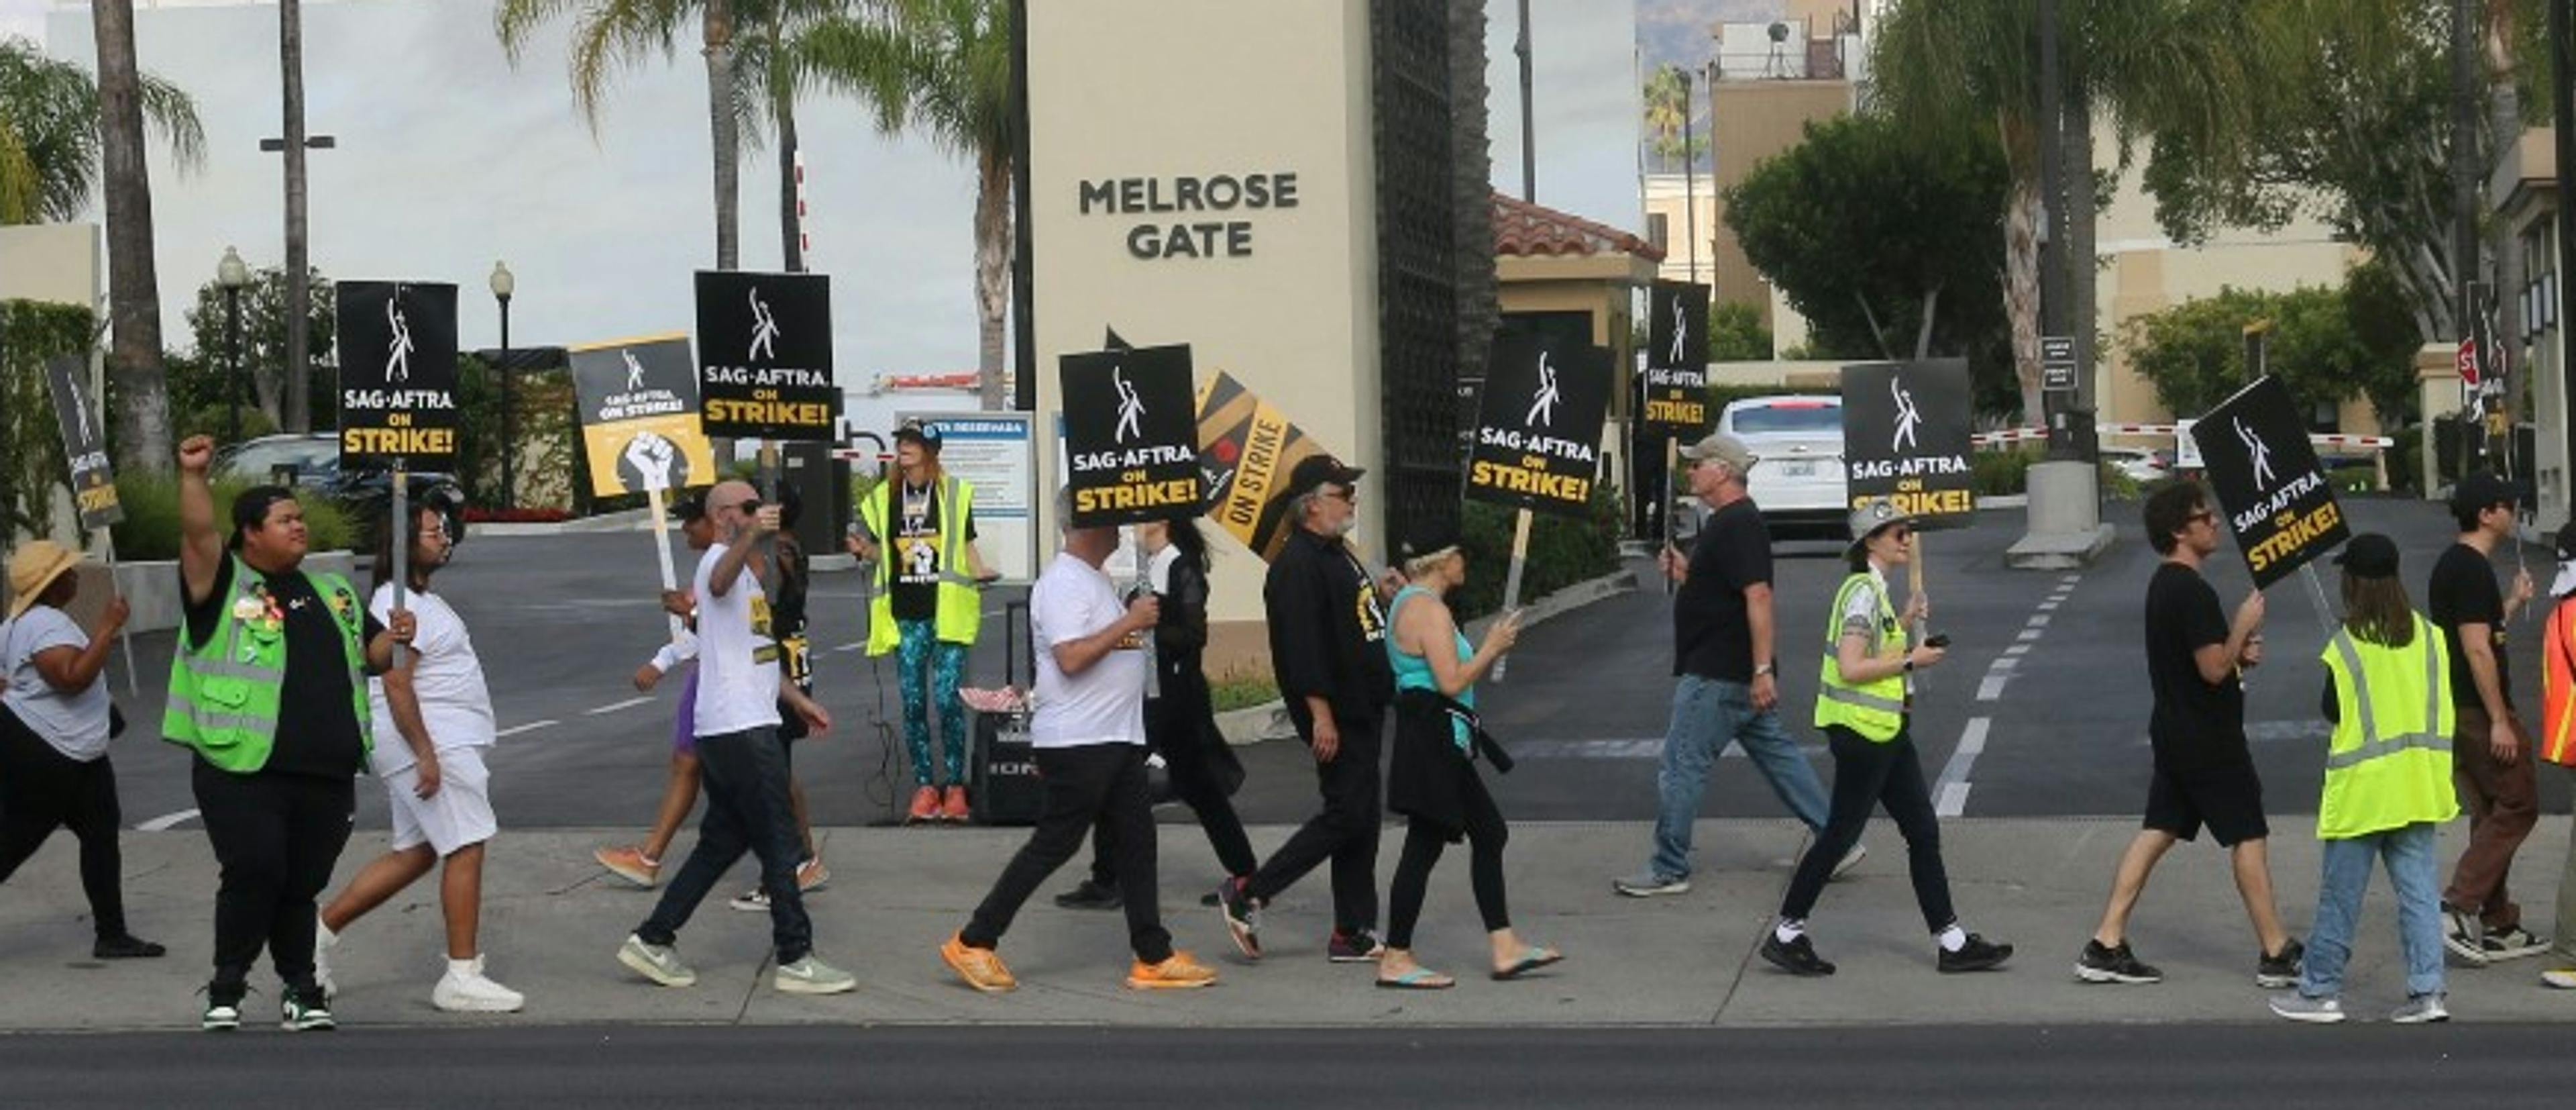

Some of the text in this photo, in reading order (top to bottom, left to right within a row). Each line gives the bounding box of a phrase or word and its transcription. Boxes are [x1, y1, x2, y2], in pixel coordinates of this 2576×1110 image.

[1079, 173, 1299, 214] MELROSE
[1127, 222, 1252, 260] GATE
[752, 389, 777, 400] ON
[388, 413, 412, 426] ON
[706, 399, 828, 425] STRIKE!
[1646, 401, 1703, 423] STRIKE!
[344, 427, 453, 453] STRIKE!
[1228, 419, 1281, 526] ON STRIKE
[1521, 454, 1547, 470] ON
[1121, 470, 1146, 483] ON
[1472, 460, 1589, 502] STRIKE!
[1897, 478, 1922, 491] ON
[1077, 478, 1198, 512] STRIKE!
[2275, 510, 2296, 527] ON
[2248, 501, 2339, 571] STRIKE!
